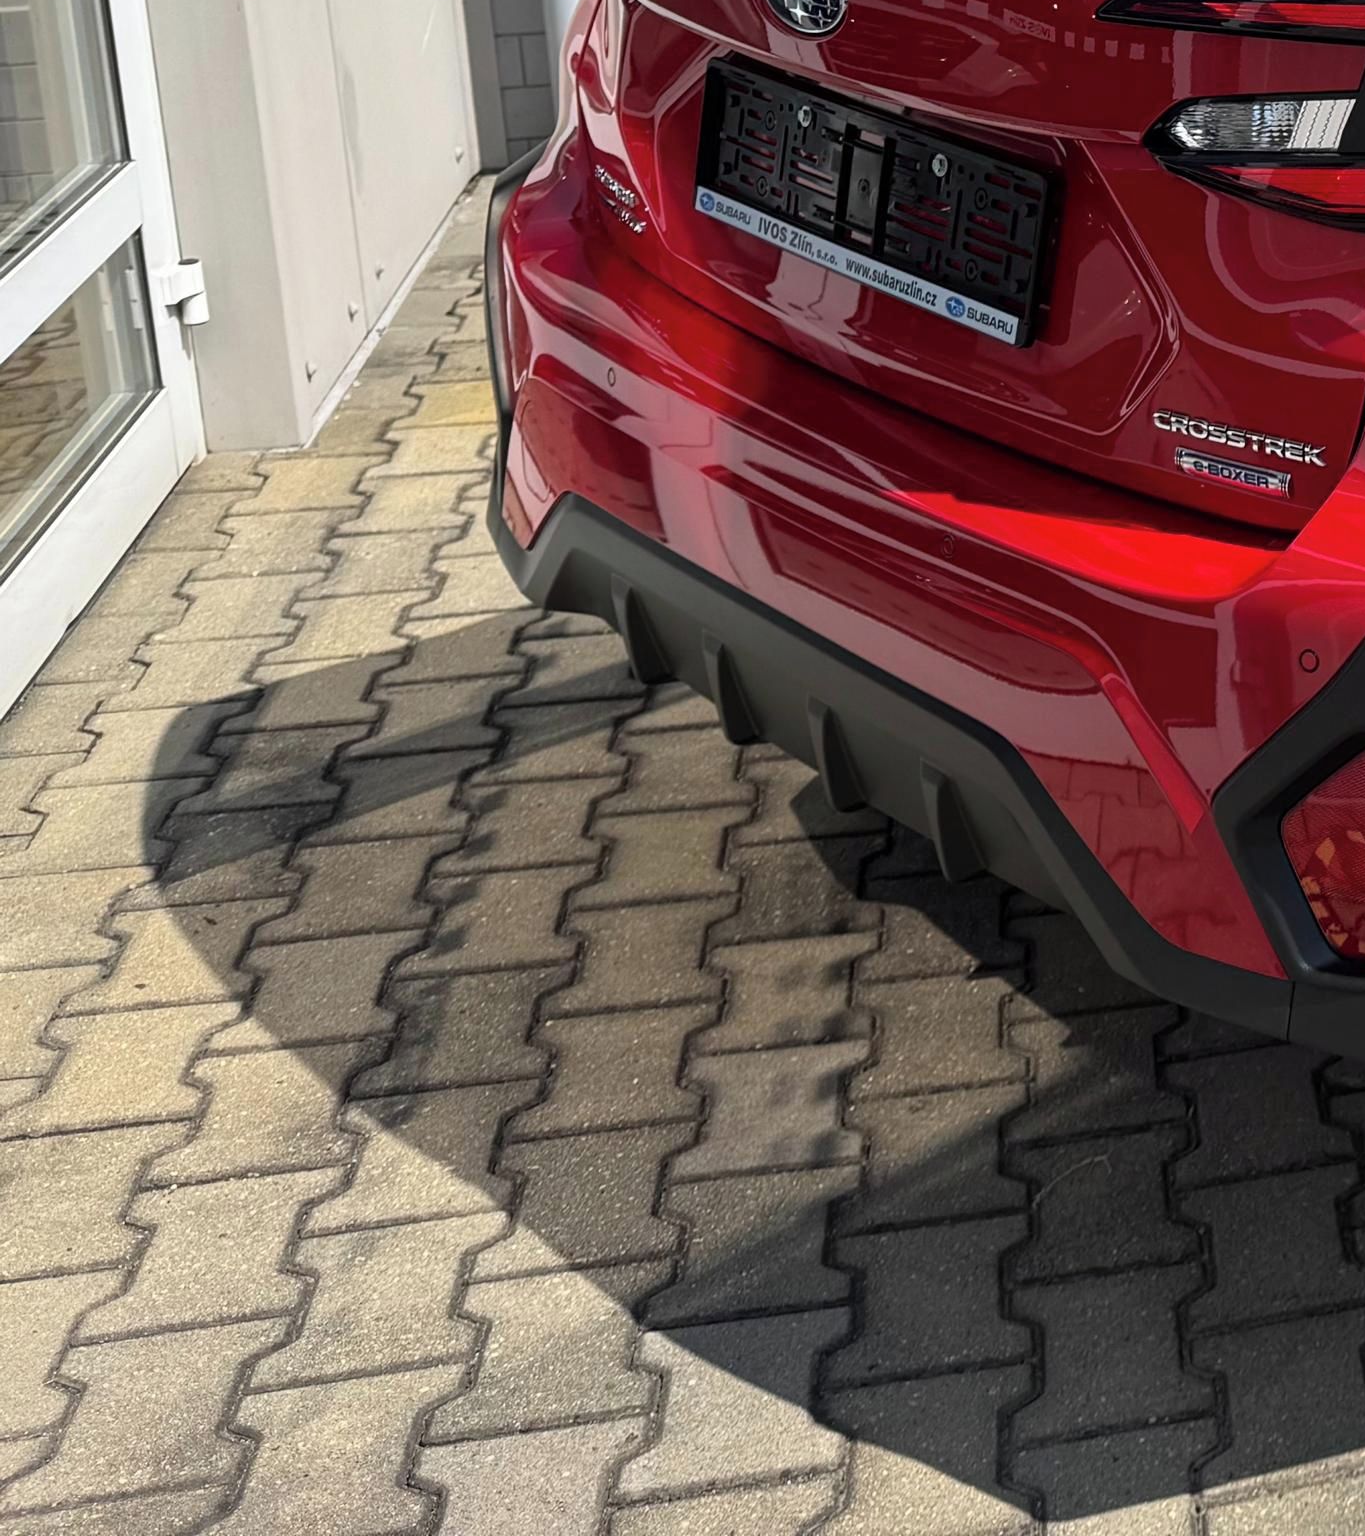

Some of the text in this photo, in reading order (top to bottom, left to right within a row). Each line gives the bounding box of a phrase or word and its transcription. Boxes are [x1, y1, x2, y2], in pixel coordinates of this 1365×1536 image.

[715, 201, 1014, 335] SUBARU IVOS Zlín, s.r.o. www.subaruzlin.cz SUBARU
[1153, 410, 1327, 467] CROSSTREK
